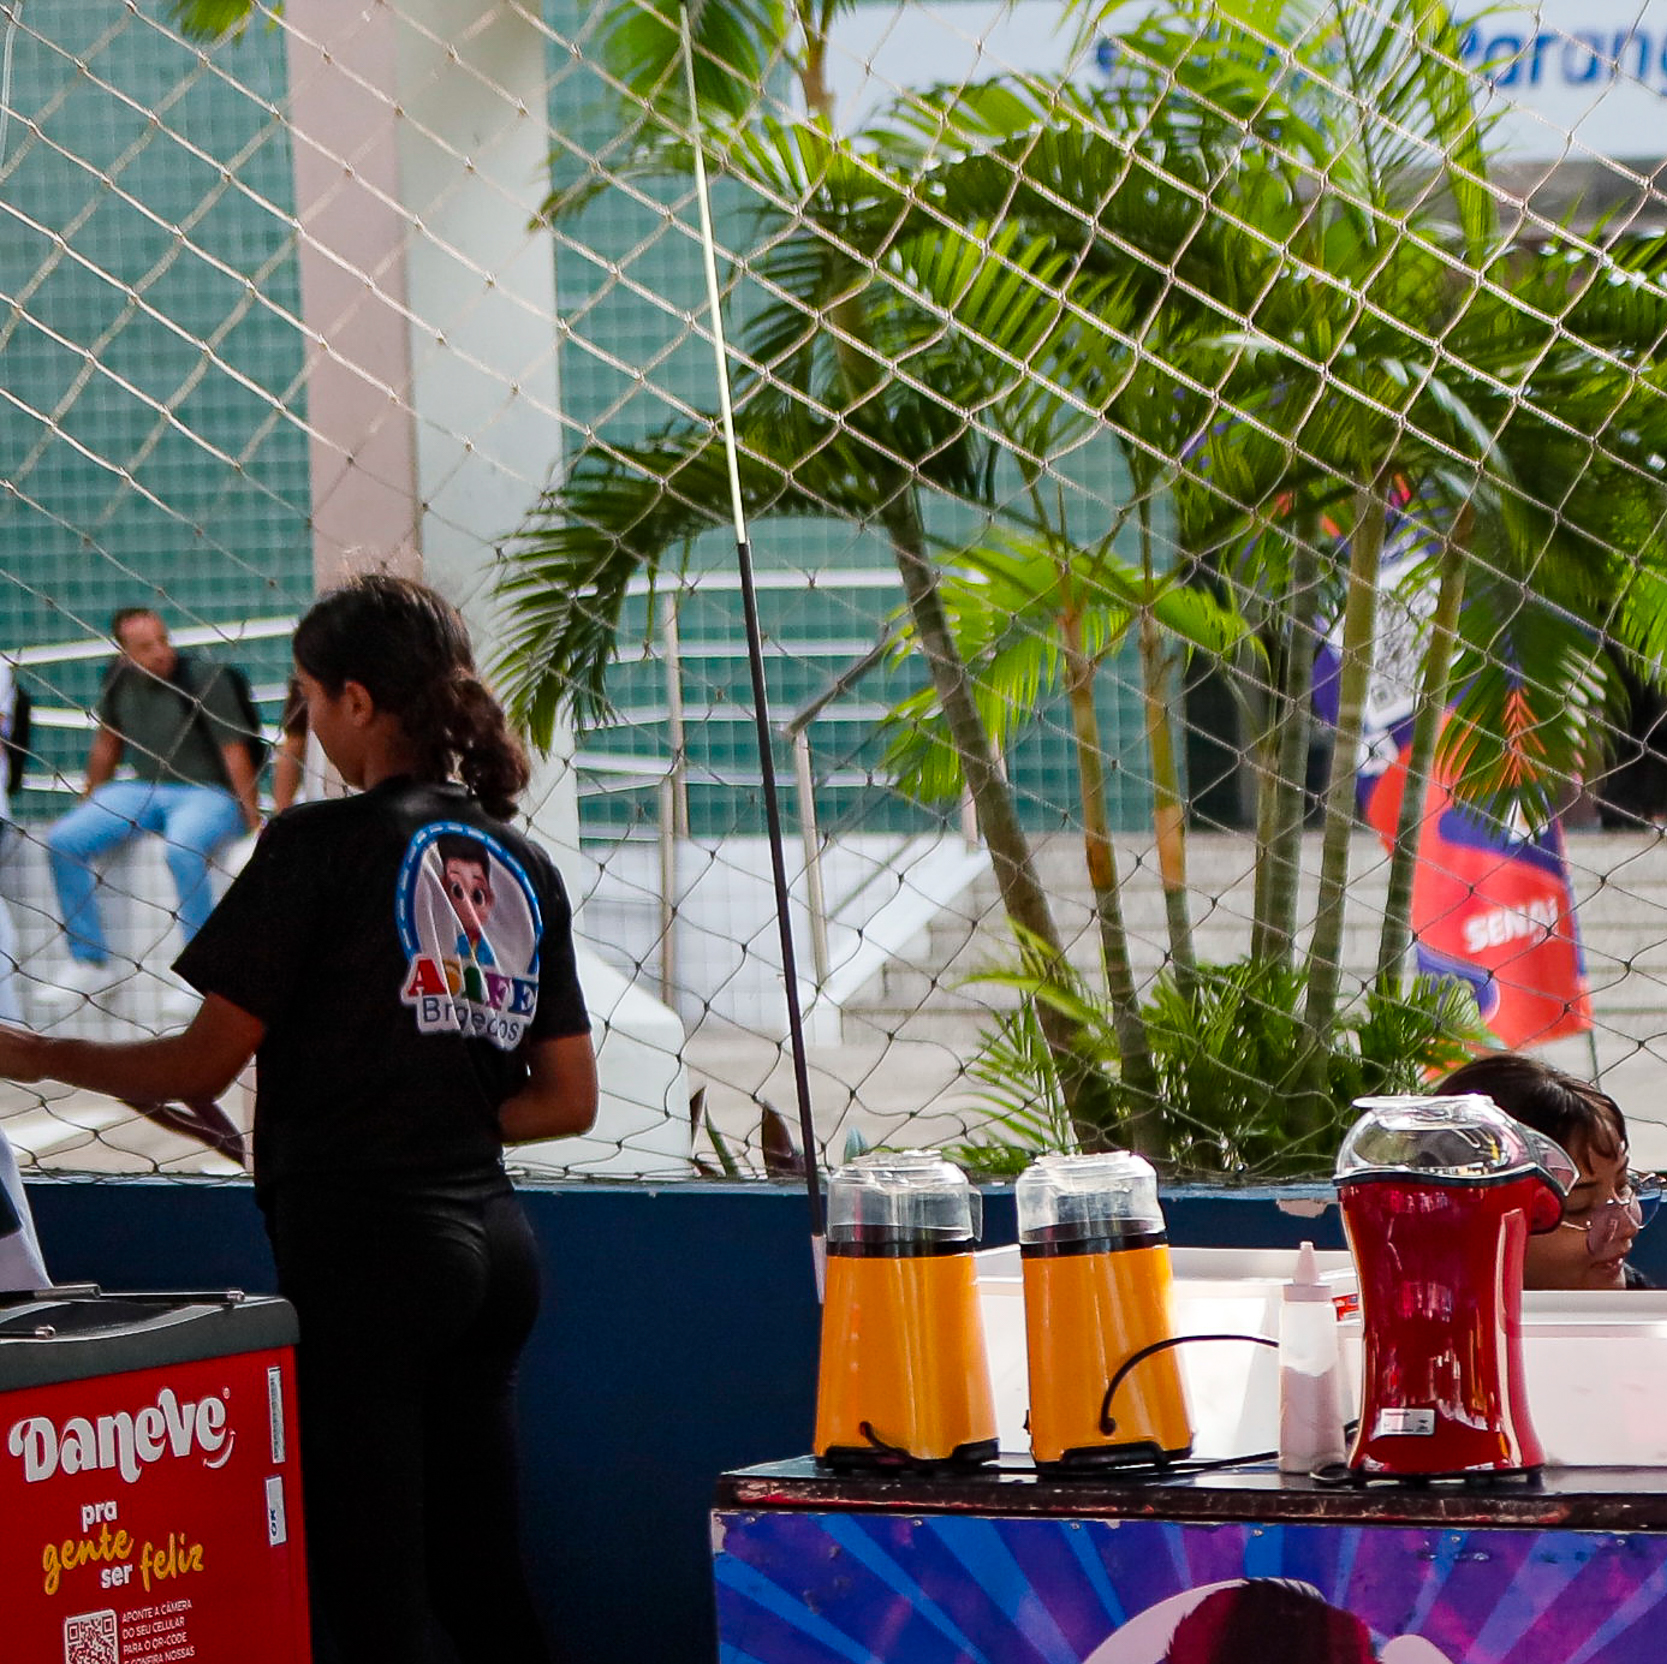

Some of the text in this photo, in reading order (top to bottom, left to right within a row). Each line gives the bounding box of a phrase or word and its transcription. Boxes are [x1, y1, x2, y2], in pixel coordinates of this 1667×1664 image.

[1465, 896, 1559, 955] SENAI
[8, 1387, 226, 1483] Daneve
[81, 1500, 118, 1532] pra
[42, 1523, 134, 1595] gente
[101, 1532, 204, 1592] ser feliz
[122, 1607, 153, 1623] APONTE
[154, 1606, 160, 1616] A
[122, 1616, 185, 1639] DO SEU CELULAR
[123, 1642, 143, 1655] PARA
[144, 1640, 150, 1651] O
[164, 1645, 195, 1661] NOSSAS
